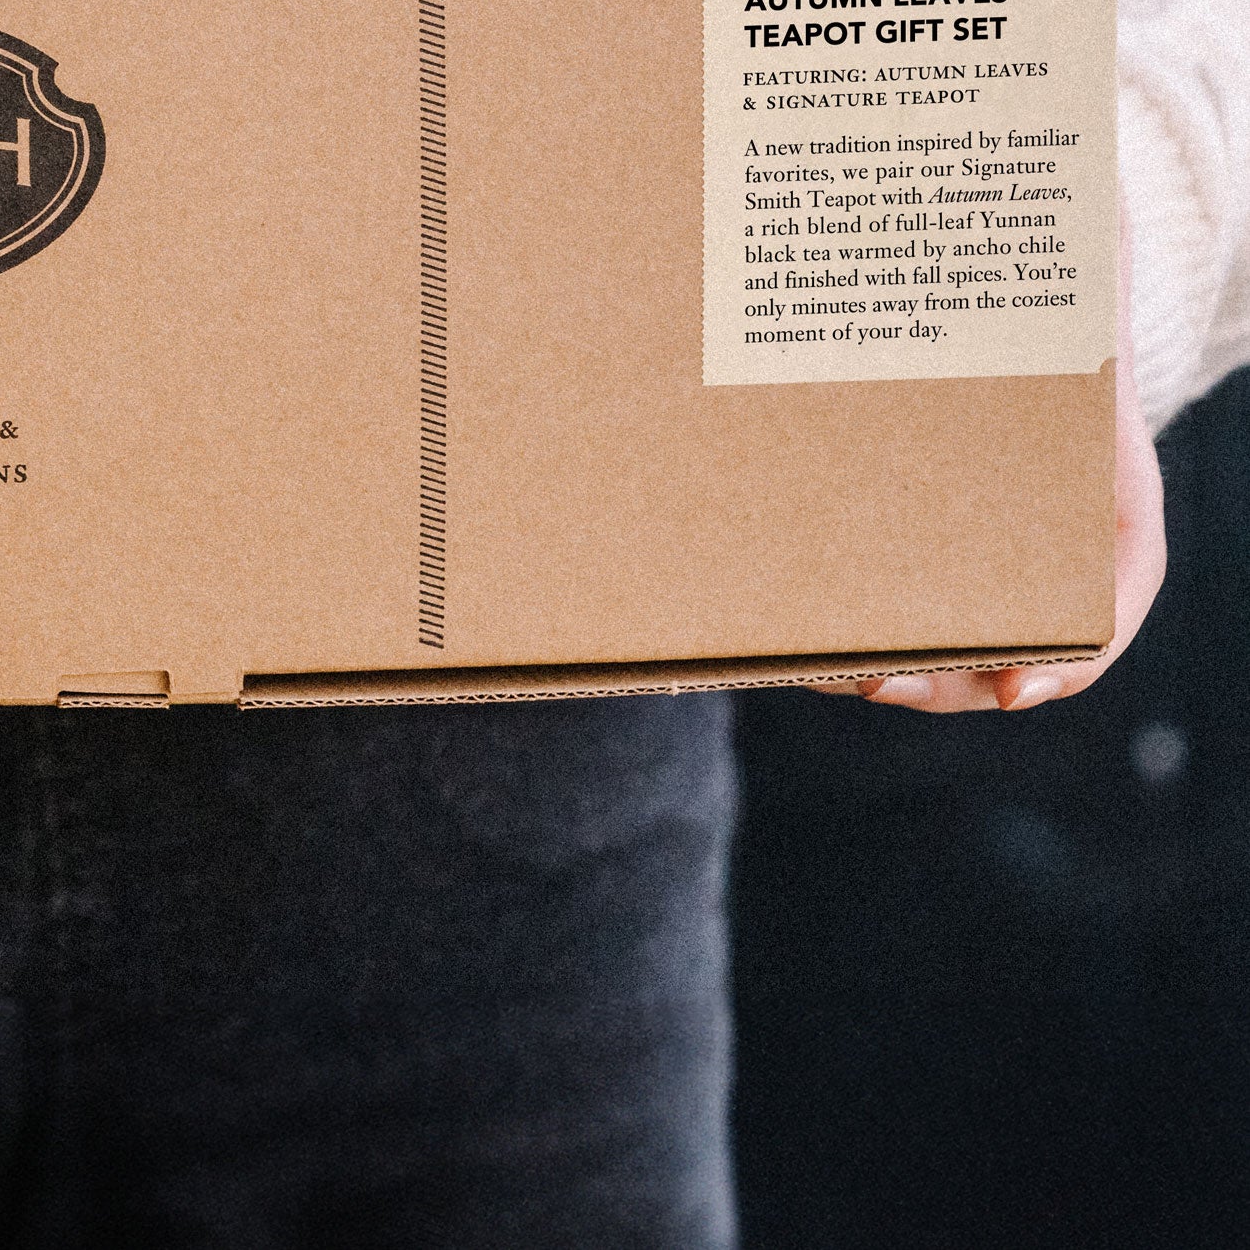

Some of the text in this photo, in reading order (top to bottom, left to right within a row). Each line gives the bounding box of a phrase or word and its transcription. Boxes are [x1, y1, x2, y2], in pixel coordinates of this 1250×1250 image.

[743, 16, 1008, 48] TEAPOT GIFT SET
[743, 62, 1048, 87] FEATURING: AUTUMN LEAVES
[742, 88, 980, 111] & SIGNATURE TEAPOT
[745, 128, 1080, 157] A new tradition inspired by familiar
[744, 157, 1056, 186] favorites, we pair our Signature
[745, 183, 1072, 213] Smith Teapot with Autumn Leaves,
[745, 210, 1057, 237] a rich blend of full-leaf Yunnan
[745, 235, 1065, 264] black tea warmed by ancho chile
[745, 262, 1077, 290] and finished with fall spices. You’re
[744, 289, 1077, 321] only minutes away from the coziest
[745, 319, 947, 345] moment of your day.
[0, 421, 18, 439] &
